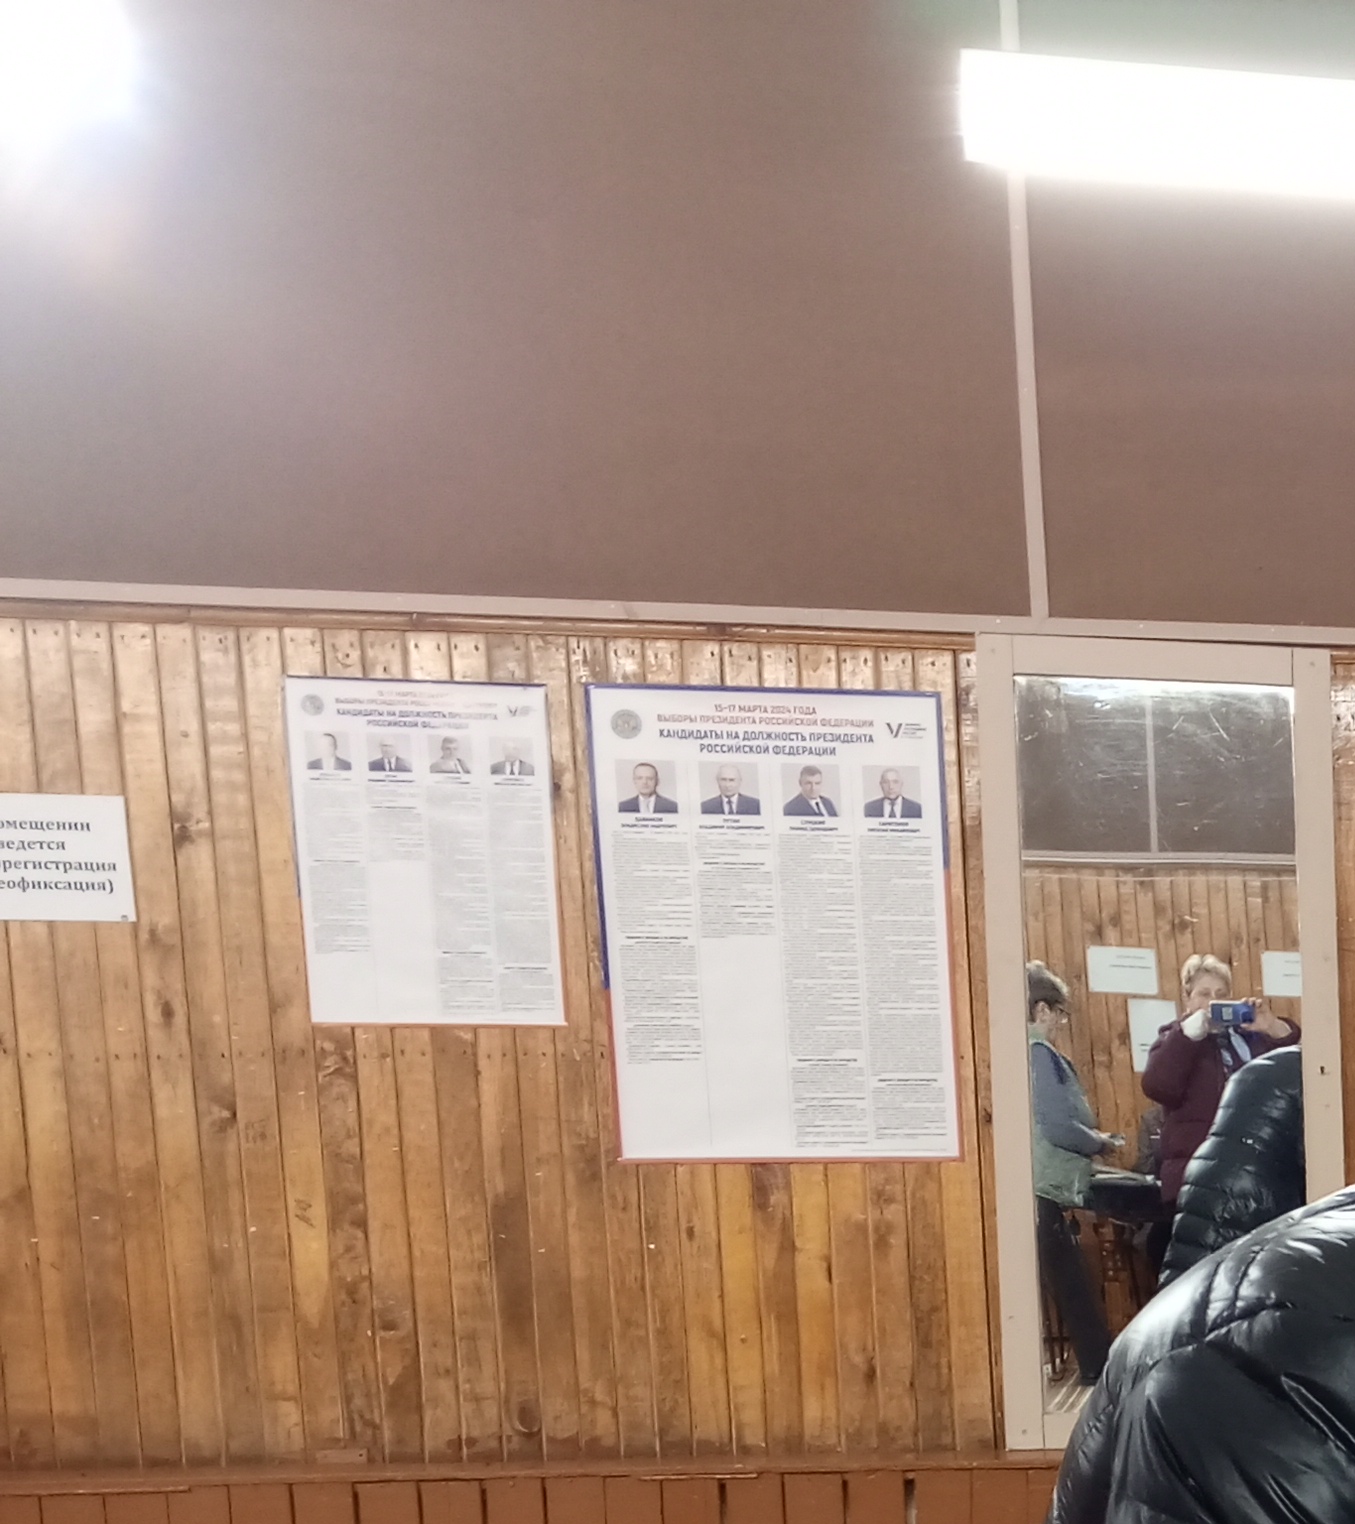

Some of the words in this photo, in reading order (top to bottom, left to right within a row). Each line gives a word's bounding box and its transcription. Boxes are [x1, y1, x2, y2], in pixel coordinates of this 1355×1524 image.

[738, 704, 769, 714] МАРТА
[657, 713, 697, 723] ВЫБОРЫ
[699, 714, 757, 725] ПРЕЗИДЕНТА
[758, 716, 818, 727] РОССИЙСКОЙ
[821, 718, 874, 729] ФЕДЕРАЦИИ
[658, 728, 724, 741] КАНДИДАТЫ
[725, 730, 741, 741] НА
[742, 730, 807, 743] ДОЛЖНОСТЬ
[809, 732, 874, 745] ПРЕЗИДЕНТА
[699, 741, 770, 755] РОССИЙСКОЙ
[772, 744, 836, 757] ФЕДЕРАЦИИ
[0, 859, 117, 874] регистрация
